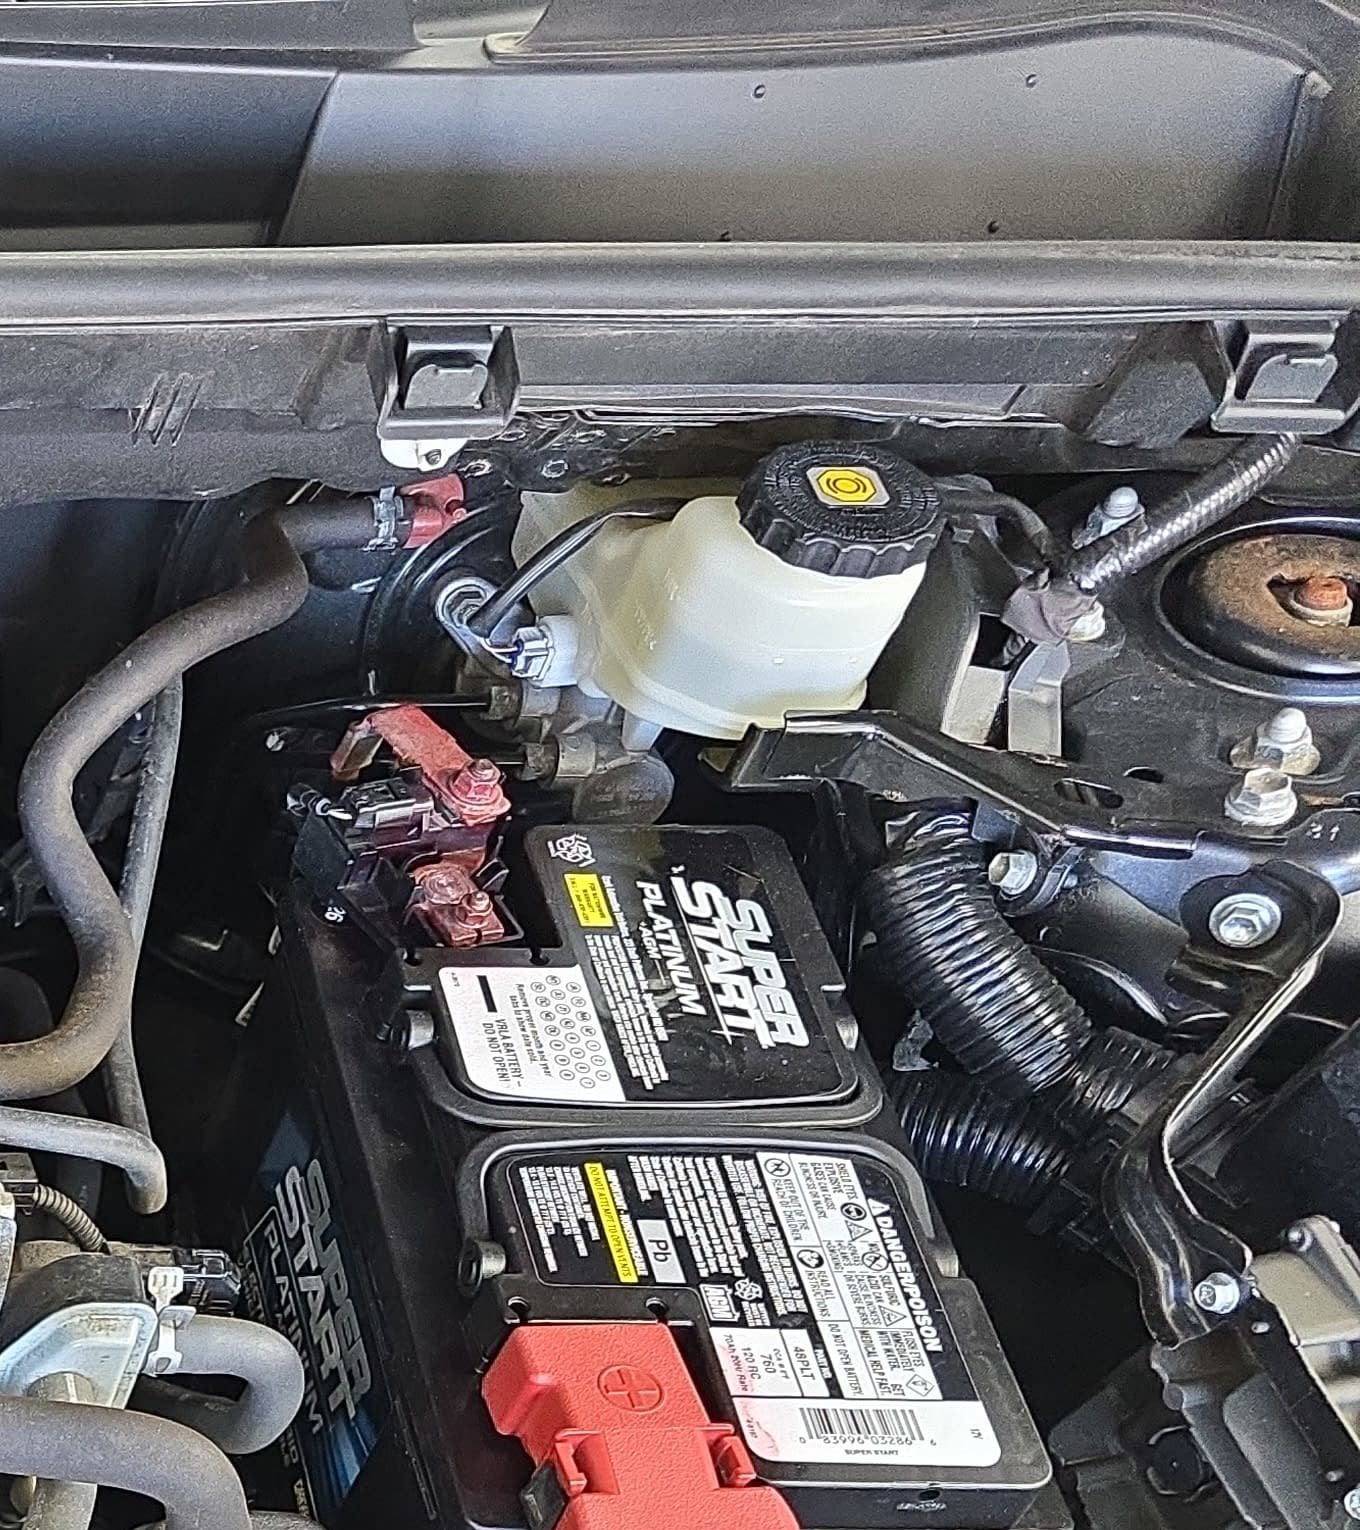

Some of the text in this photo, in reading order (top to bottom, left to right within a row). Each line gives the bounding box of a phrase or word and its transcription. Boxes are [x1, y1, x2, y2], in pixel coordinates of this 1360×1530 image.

[634, 881, 707, 1015] PLATINUM
[637, 926, 662, 959] AGM
[668, 876, 775, 1049] START
[718, 896, 811, 1046] SUPER
[514, 983, 531, 1007] Remove
[493, 1018, 512, 1040] VRLA
[515, 1016, 528, 1032] show
[520, 1033, 533, 1047] date
[481, 1022, 511, 1082] DO NOT OPEN!
[500, 1042, 524, 1079] BATTERY
[536, 1050, 548, 1061] and
[538, 1062, 552, 1077] year
[588, 1166, 600, 1176] DO
[591, 1177, 605, 1190] NOT
[781, 1178, 796, 1193] KEEP
[596, 1192, 615, 1222] ATTEMPT
[778, 1200, 791, 1209] OF
[787, 1194, 801, 1207] OUT
[792, 1207, 805, 1216] OF
[606, 1224, 618, 1233] TO
[609, 1234, 625, 1254] OPEN
[647, 1238, 674, 1262] Pb
[307, 1159, 372, 1397] SUPER
[815, 1270, 836, 1300] READ ALL
[865, 1274, 881, 1291] ACID
[874, 1215, 944, 1352] DANGER/POISON
[275, 1165, 357, 1419] START
[878, 1274, 900, 1306] SULFURIC
[703, 1286, 733, 1318] AGM
[830, 1333, 846, 1347] NOT
[875, 1330, 893, 1346] WITH
[835, 1348, 853, 1365] OPEN
[888, 1330, 914, 1371] IMMEDIATELY
[740, 1346, 762, 1380] 120 RC
[759, 1353, 777, 1374] 760
[791, 1346, 816, 1381] 48PLT
[857, 1329, 893, 1396] MEDICAL HELP FAST.
[871, 1435, 913, 1446] 03286
